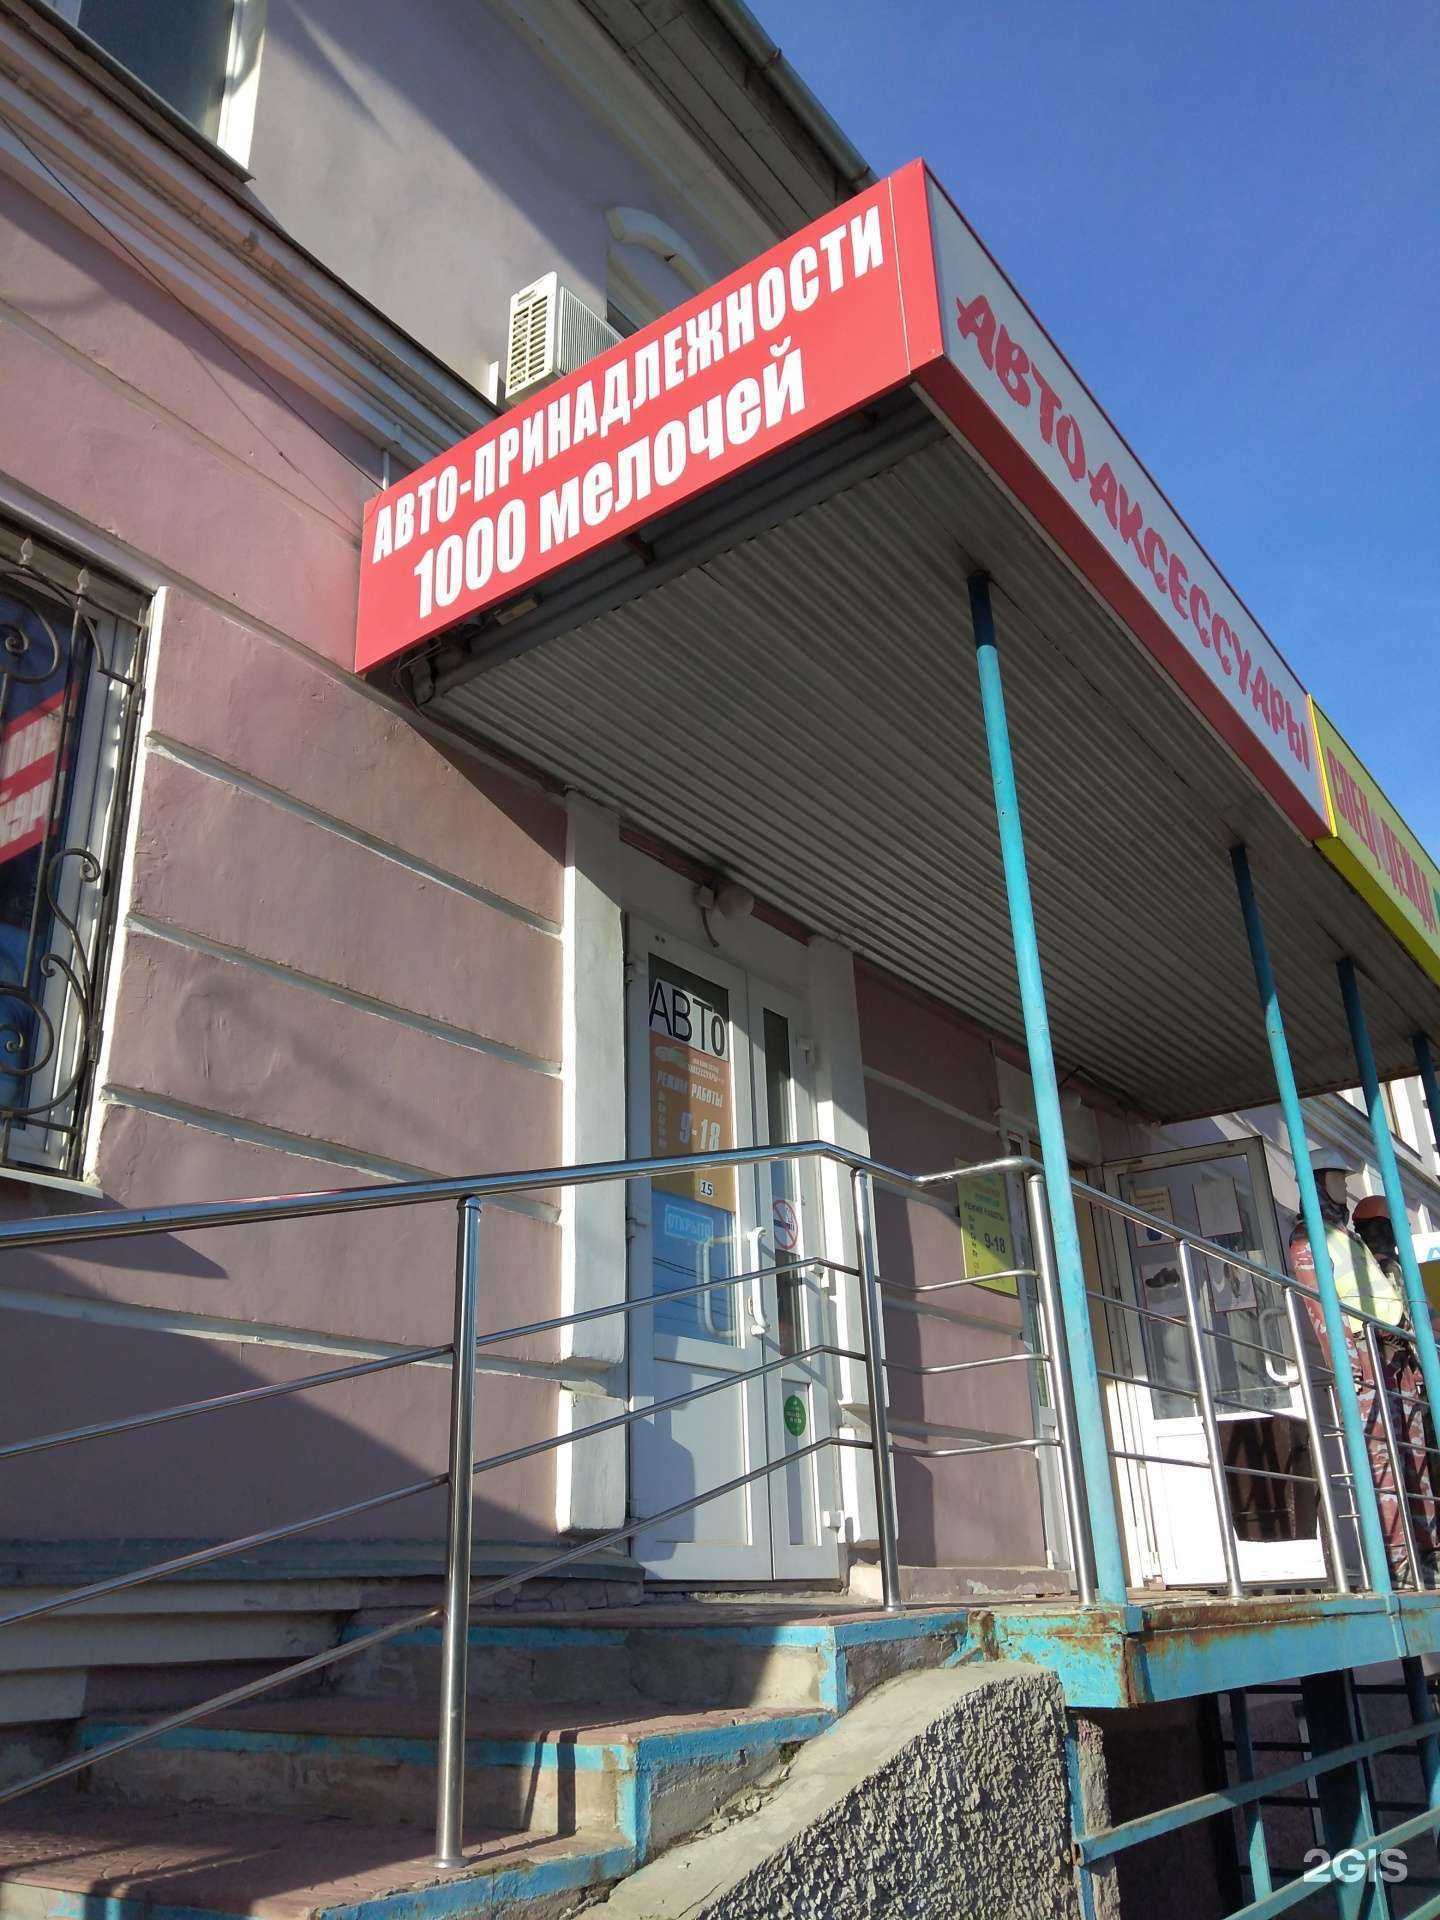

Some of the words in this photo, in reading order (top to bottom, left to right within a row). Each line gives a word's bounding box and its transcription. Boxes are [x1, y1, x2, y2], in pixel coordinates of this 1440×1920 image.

[372, 204, 885, 564] АВТО-ПРИНАДЛЕЖНОСТИ
[413, 502, 527, 619] 1000
[538, 335, 806, 554] мелочей
[956, 294, 1311, 772] АВТОАКСЕССУАРЫ
[691, 1083, 724, 1108] РАБОТЫ
[700, 1181, 713, 1196] 15
[984, 1232, 1006, 1254] 9-18
